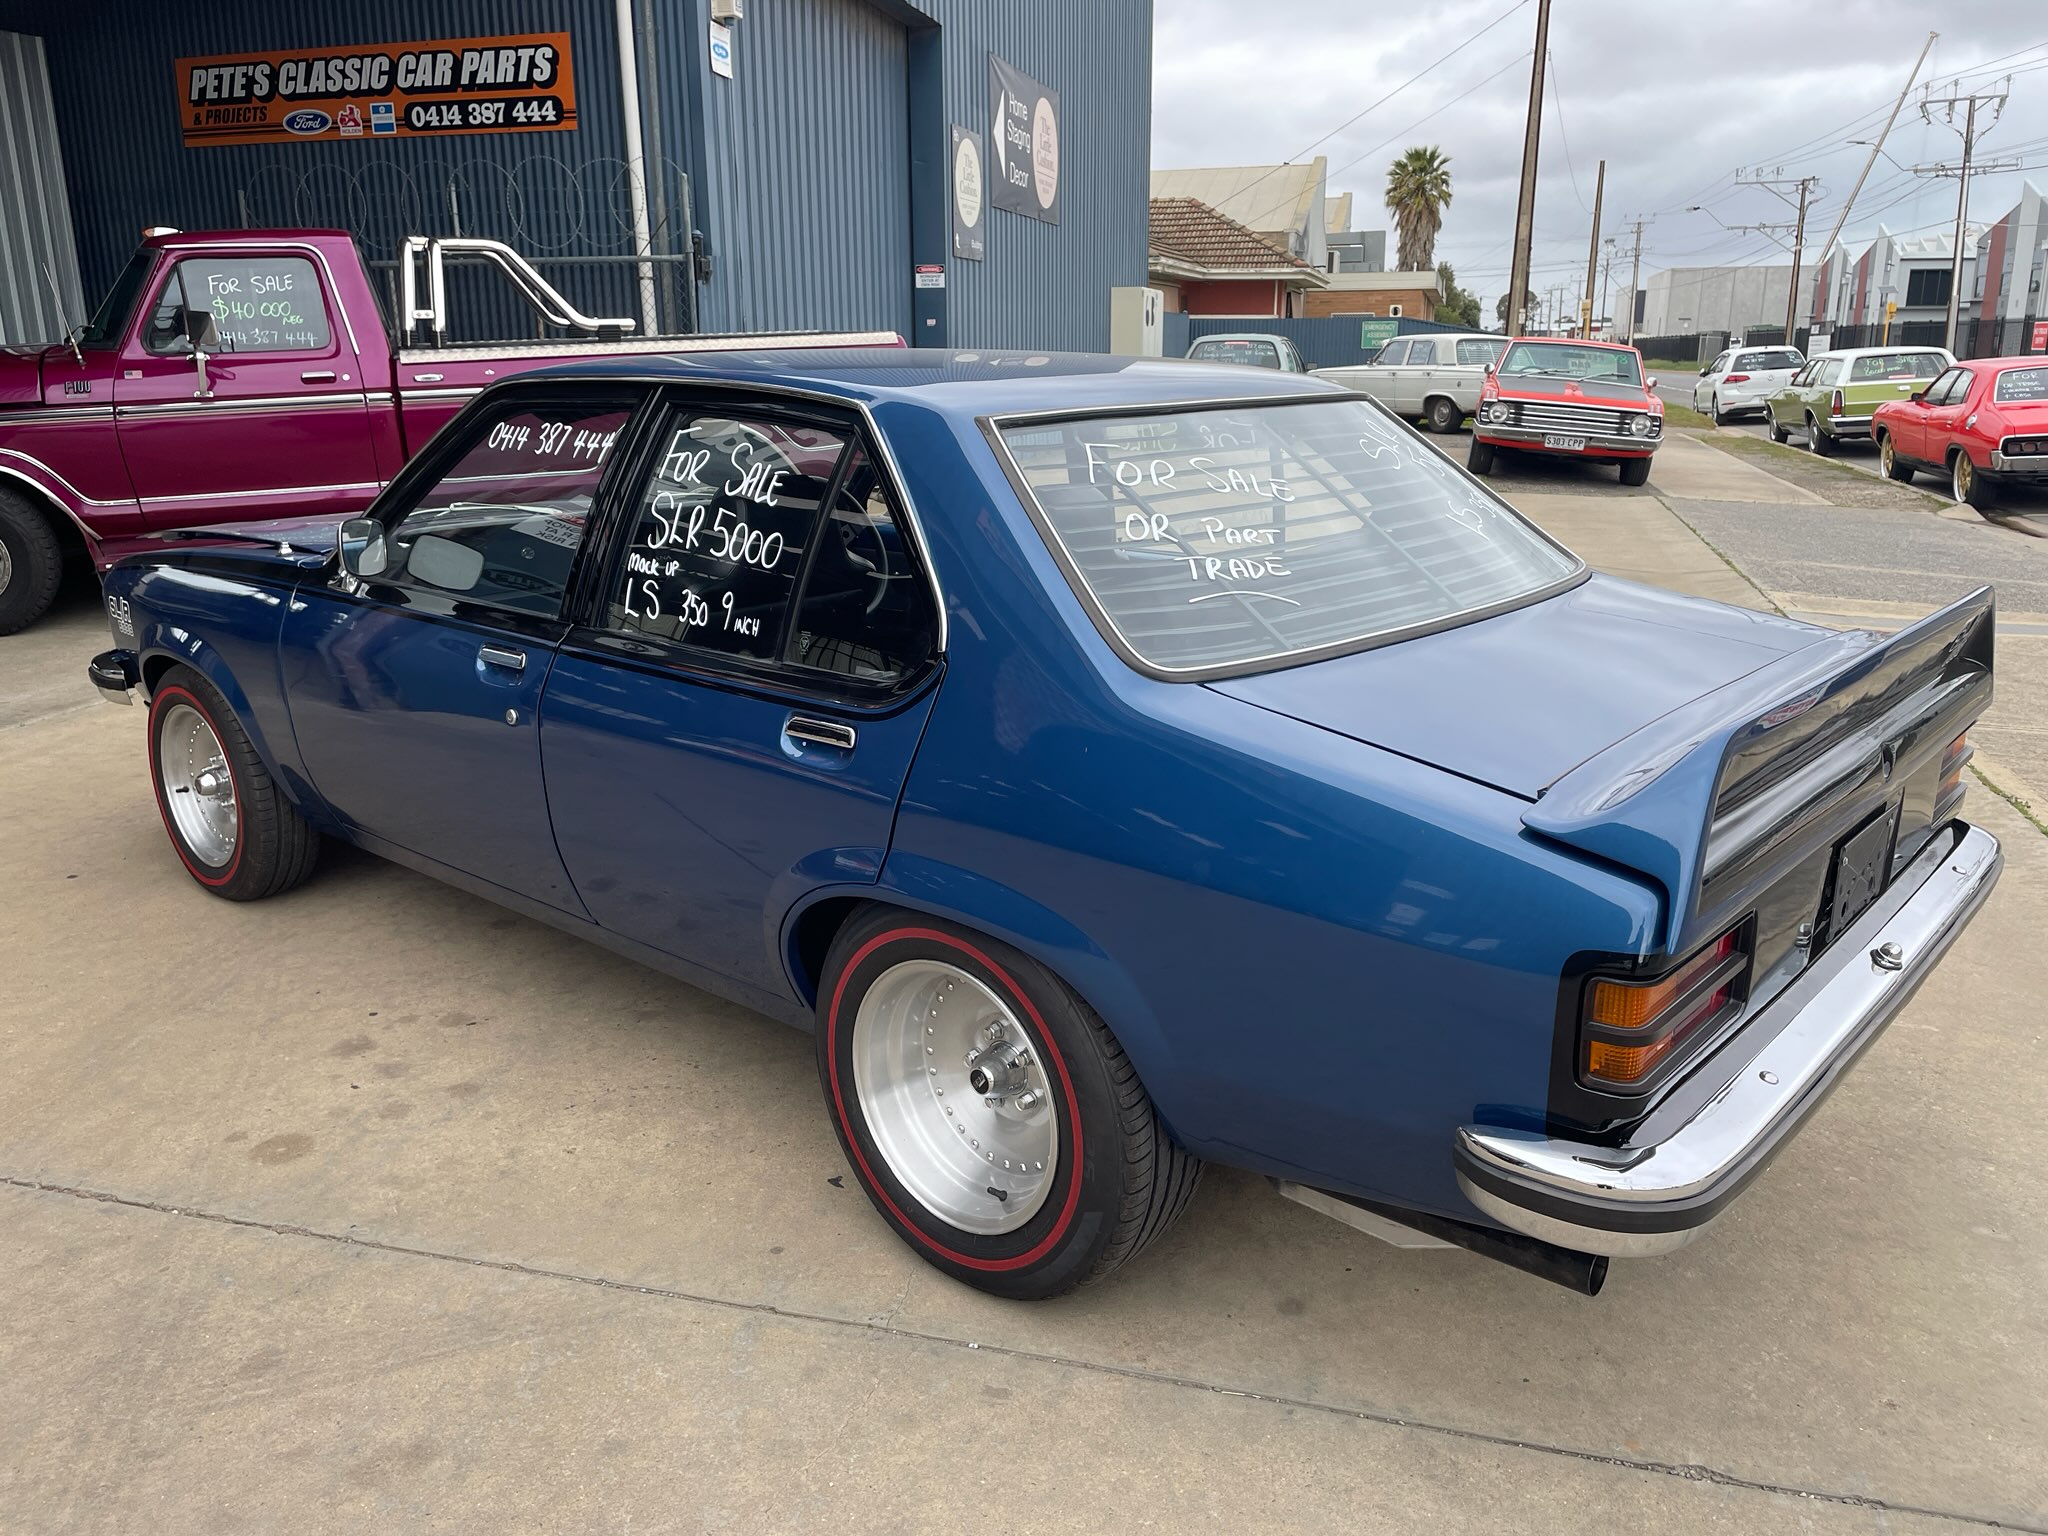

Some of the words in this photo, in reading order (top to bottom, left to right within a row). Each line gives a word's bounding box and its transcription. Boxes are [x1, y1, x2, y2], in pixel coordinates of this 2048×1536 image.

[190, 65, 269, 101] PETE'S
[278, 56, 390, 95] CLASSIC
[398, 53, 452, 88] CAR
[460, 47, 554, 85] PARTS
[193, 113, 202, 126] &
[205, 105, 268, 125] PROJECTS
[412, 105, 463, 128] 0414
[468, 102, 506, 125] 387
[513, 99, 558, 123] 444
[1008, 92, 1028, 120] Home
[293, 114, 322, 129] Ford
[1007, 119, 1031, 154] Staging
[1009, 161, 1029, 189] Decor
[208, 274, 242, 295] FOR
[250, 274, 293, 294] SALE
[212, 295, 255, 324] $40
[260, 301, 291, 317] 000
[282, 315, 304, 326] NEG
[250, 327, 278, 345] 387
[285, 331, 318, 347] 444
[1866, 358, 1885, 366] FOR
[2012, 372, 2039, 380] FOR
[488, 420, 531, 455] 0414
[534, 421, 571, 456] 387
[573, 426, 615, 465] 444
[1546, 436, 1566, 446] S303
[1567, 438, 1584, 448] CPP
[658, 425, 711, 485] FOR
[724, 442, 790, 507] SALE
[1084, 443, 1177, 490] FOR
[1188, 456, 1296, 503] SALE
[647, 490, 704, 551] SLR
[708, 507, 784, 569] 5000
[1124, 512, 1180, 543] OR
[1199, 516, 1283, 546] PART
[665, 560, 680, 577] UP
[1172, 555, 1292, 582] TRADE
[624, 577, 660, 620] LS
[678, 589, 708, 627] 350
[722, 591, 734, 631] 9
[733, 615, 760, 637] INCH
